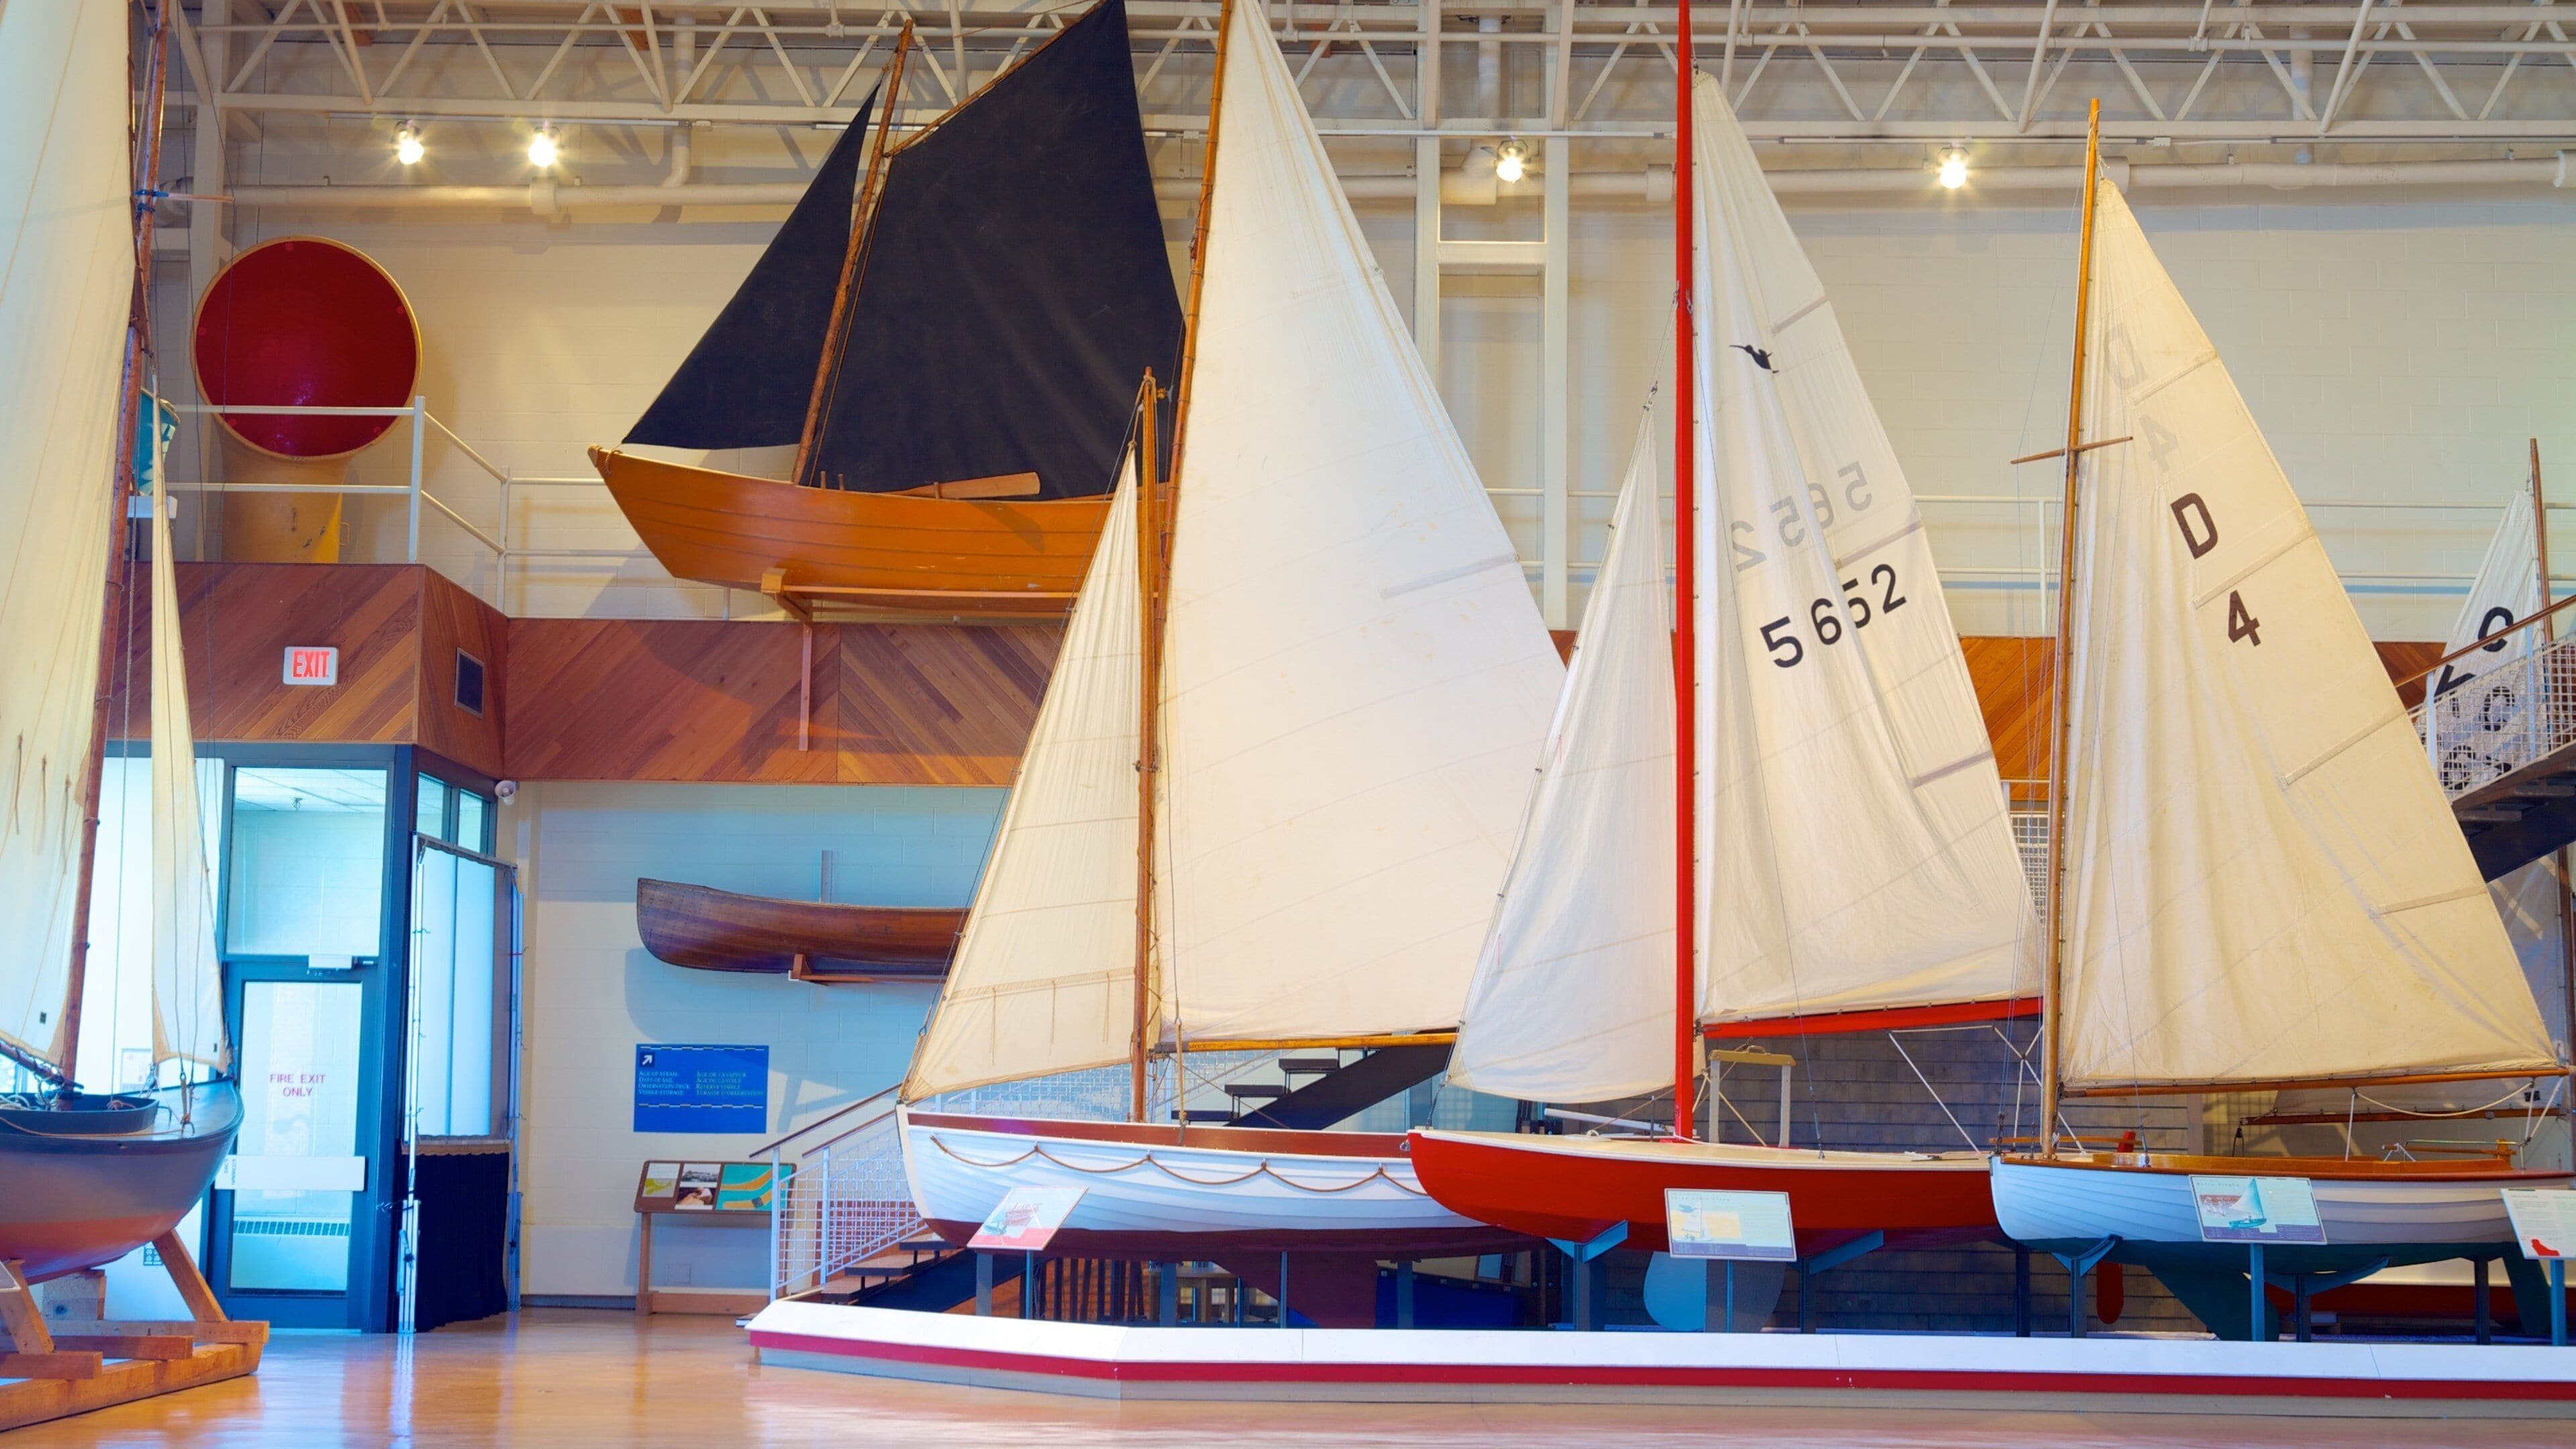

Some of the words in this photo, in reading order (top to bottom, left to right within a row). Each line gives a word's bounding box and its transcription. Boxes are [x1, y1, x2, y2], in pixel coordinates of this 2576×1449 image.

[2170, 492, 2218, 559] D
[1759, 564, 1907, 668] 5652
[2228, 590, 2261, 647] 4
[293, 651, 330, 678] EXIT
[270, 1074, 294, 1083] FIRE
[301, 1074, 326, 1083] EXIT
[282, 1087, 313, 1097] ONLY
